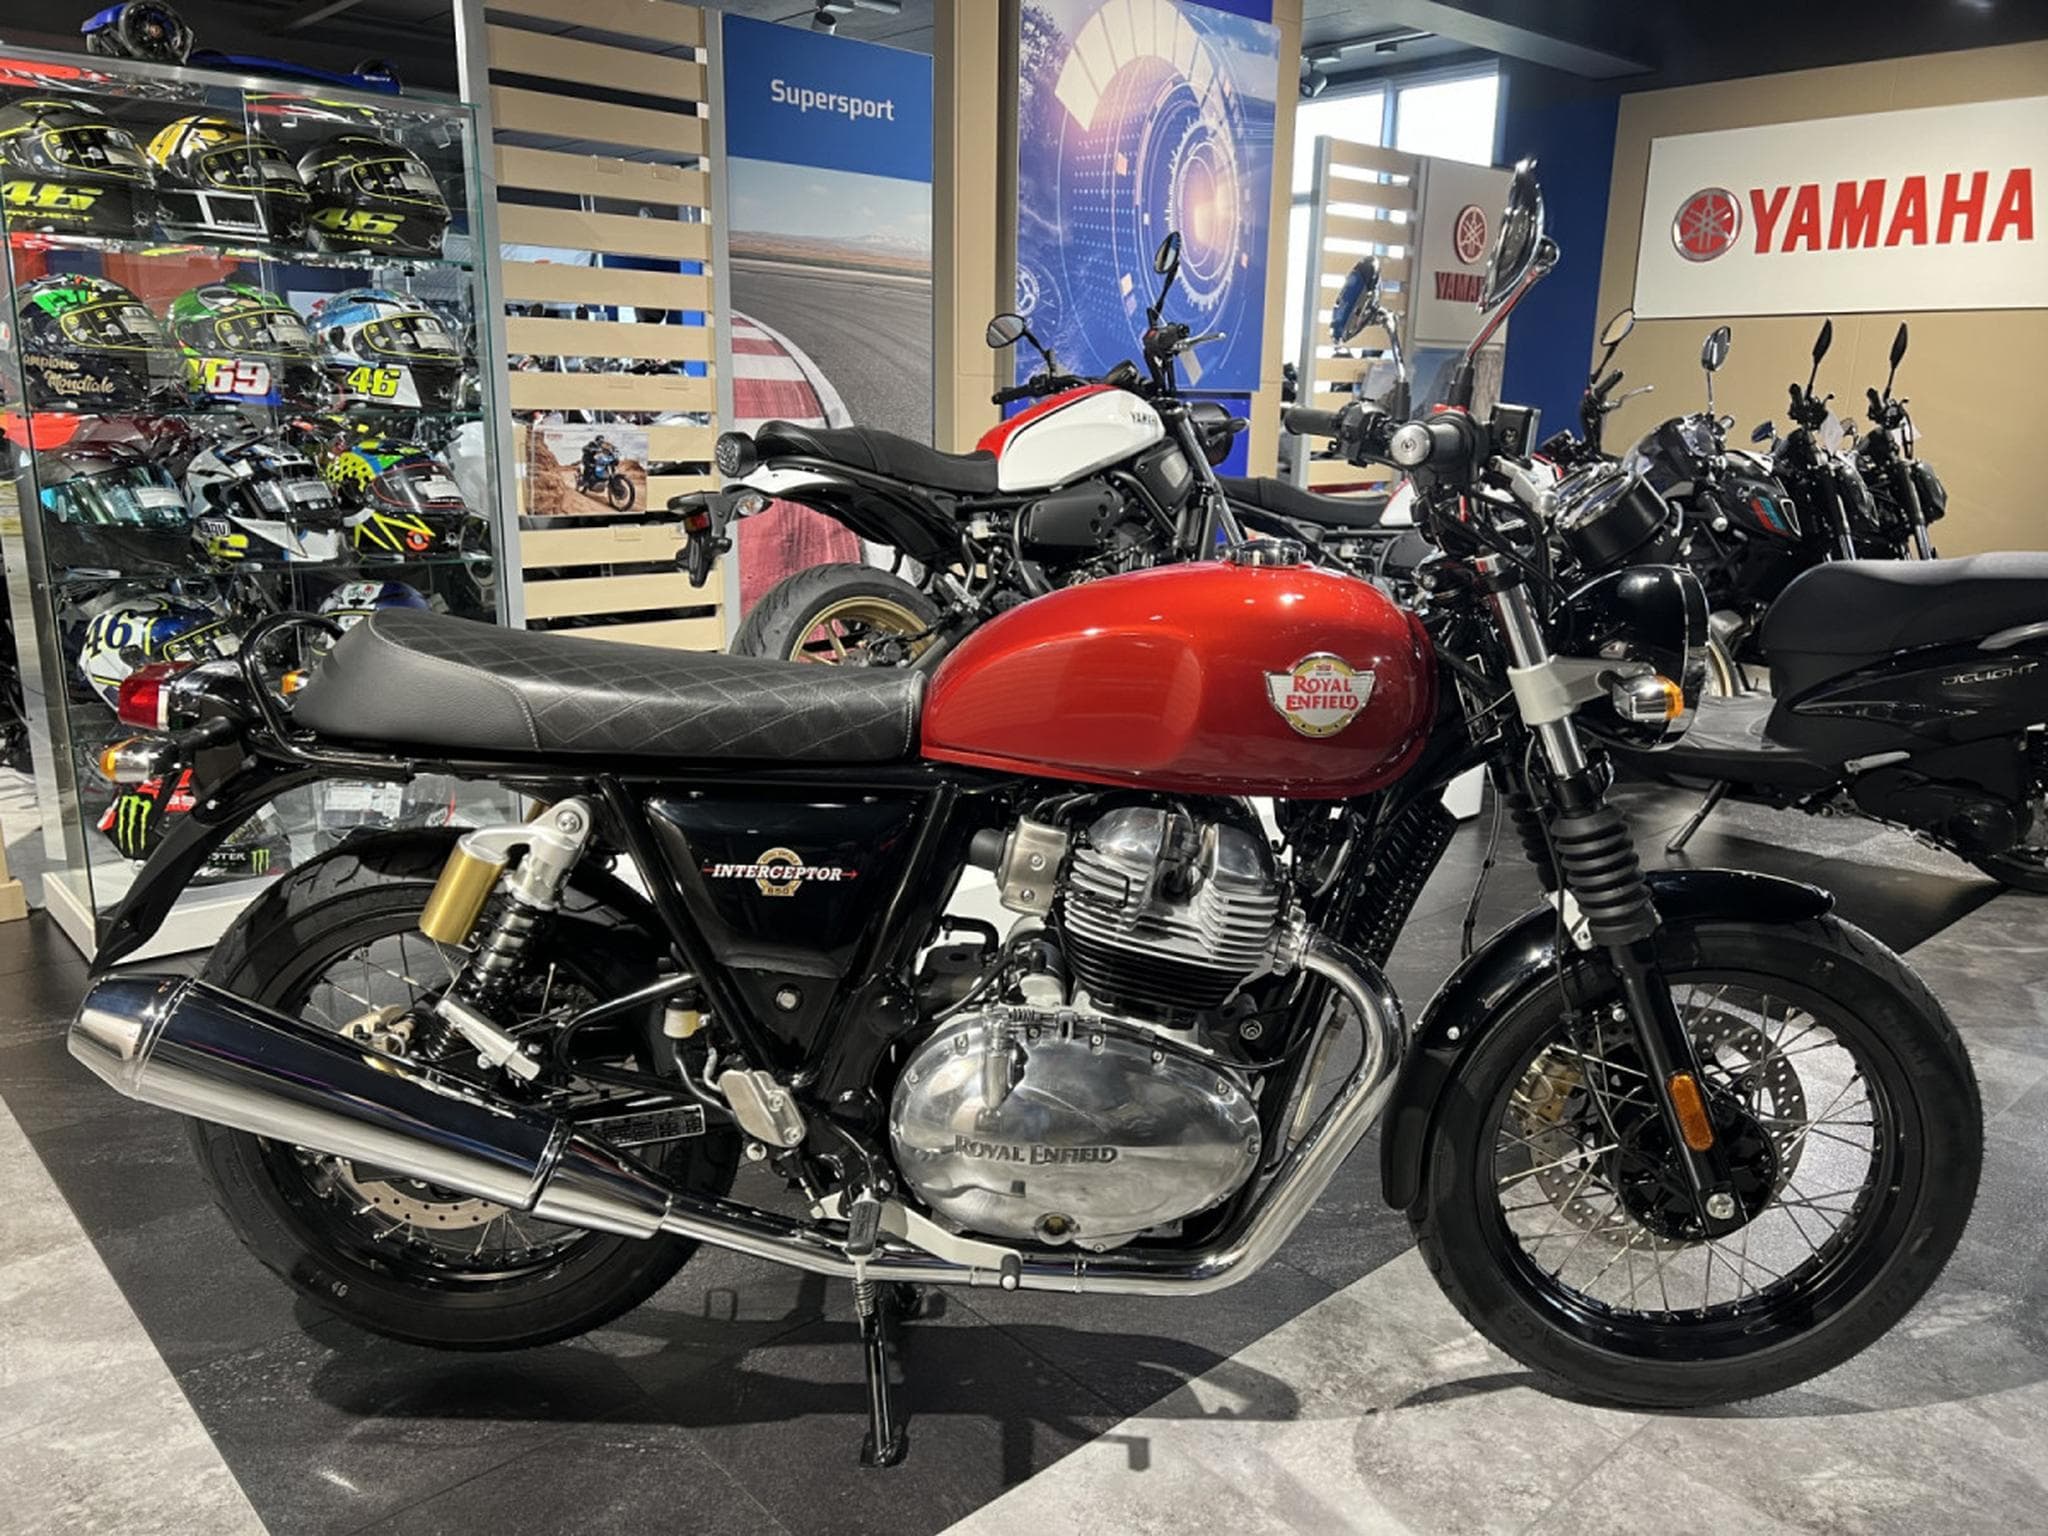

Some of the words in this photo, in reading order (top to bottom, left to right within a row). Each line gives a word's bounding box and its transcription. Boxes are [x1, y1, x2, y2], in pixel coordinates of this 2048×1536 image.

[770, 79, 895, 121] Supersport
[1, 181, 104, 210] 46
[312, 208, 405, 235] 46
[1749, 168, 2034, 255] YAMAHA
[1435, 271, 1485, 303] YAMA
[22, 353, 80, 371] ampione
[204, 357, 273, 396] 69
[348, 365, 401, 398] 46
[85, 609, 138, 658] 46
[1293, 675, 1352, 693] ROYAL
[1286, 695, 1359, 712] ENFIELD
[711, 863, 843, 881] INTERCEPTOR
[955, 1134, 1025, 1162] ROYAL
[1030, 1144, 1118, 1165] ENFIELD
